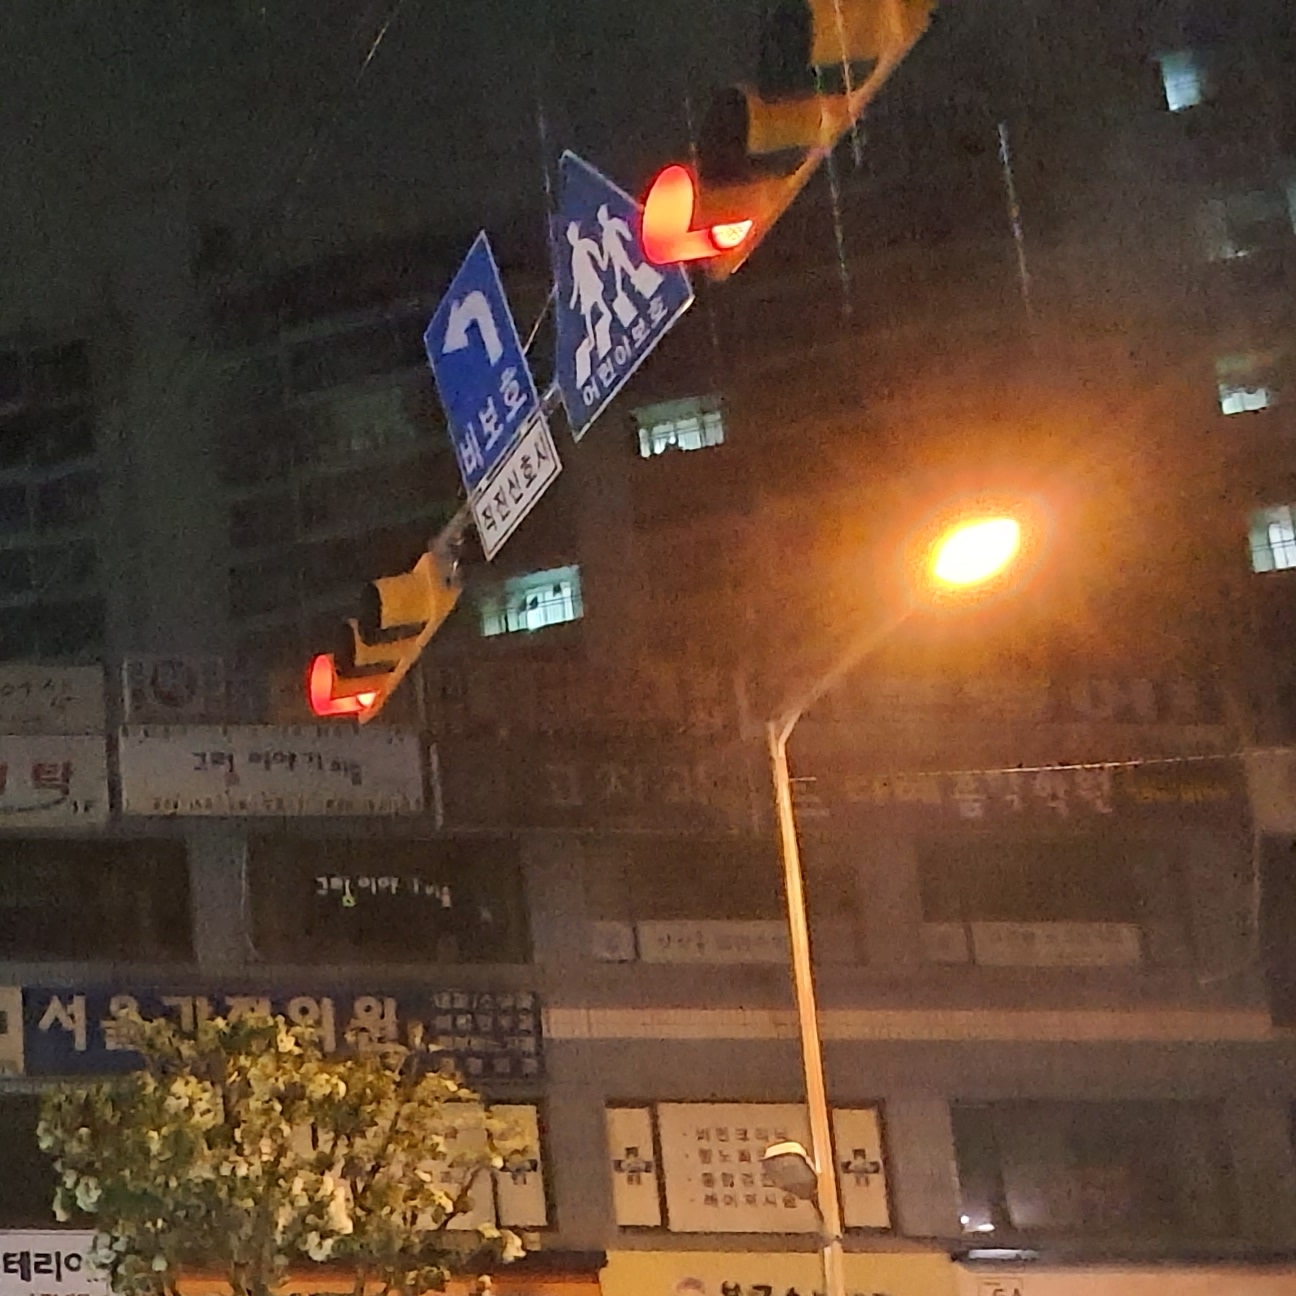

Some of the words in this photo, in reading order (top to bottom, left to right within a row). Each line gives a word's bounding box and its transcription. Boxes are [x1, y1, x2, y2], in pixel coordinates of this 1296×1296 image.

[583, 296, 667, 406] 어린이보호
[460, 366, 527, 476] 비보호
[481, 431, 550, 531] 직진신호시
